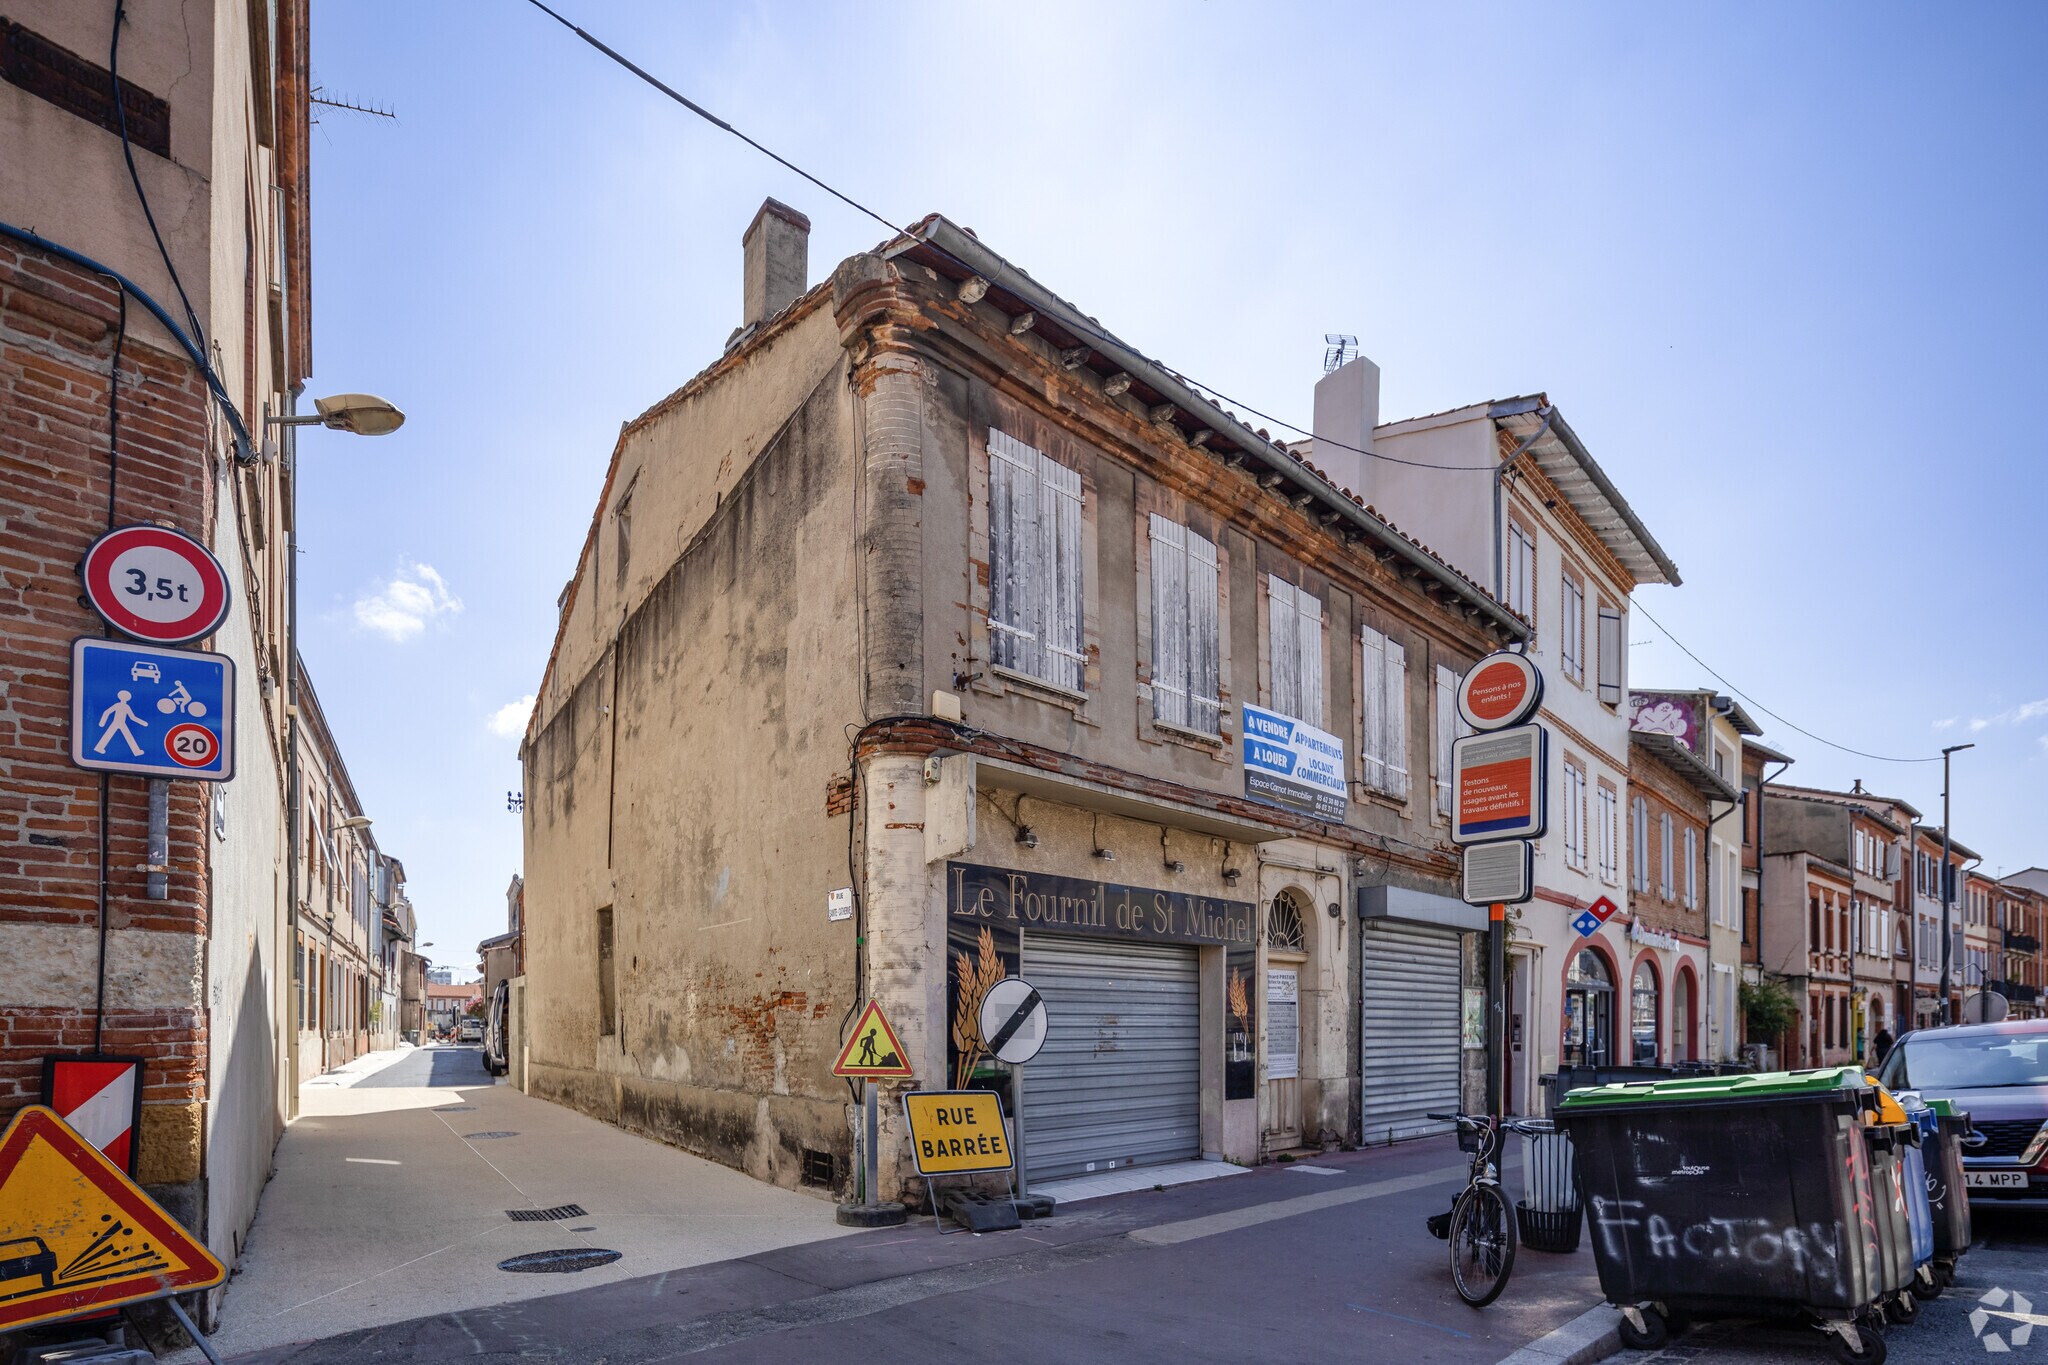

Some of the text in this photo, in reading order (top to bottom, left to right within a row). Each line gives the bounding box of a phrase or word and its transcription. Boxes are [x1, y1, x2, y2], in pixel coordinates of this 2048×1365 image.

[1472, 685, 1500, 696] Pensons
[1481, 693, 1507, 703] enfants
[1248, 716, 1288, 739] A VENDRE
[177, 736, 206, 754] 20
[1295, 732, 1342, 760] APPARTEMENTS
[1254, 747, 1287, 768] A LOUER
[1309, 758, 1334, 775] LOCAUX
[1297, 767, 1345, 791] COMMERCIAUX
[1464, 778, 1489, 786] Testons
[1250, 777, 1269, 789] Espace
[1288, 787, 1313, 801] Immobilier
[1473, 784, 1507, 794] nouveaux
[1463, 805, 1488, 814] travaux
[1490, 800, 1520, 810] définitifs
[1464, 797, 1486, 806] usages
[1488, 793, 1507, 801] avant
[953, 867, 1251, 942] Le Fournil de St Michel
[936, 1107, 976, 1125] RUE
[921, 1133, 1003, 1158] BARRÉE
[1989, 1174, 2021, 1185] MPP
